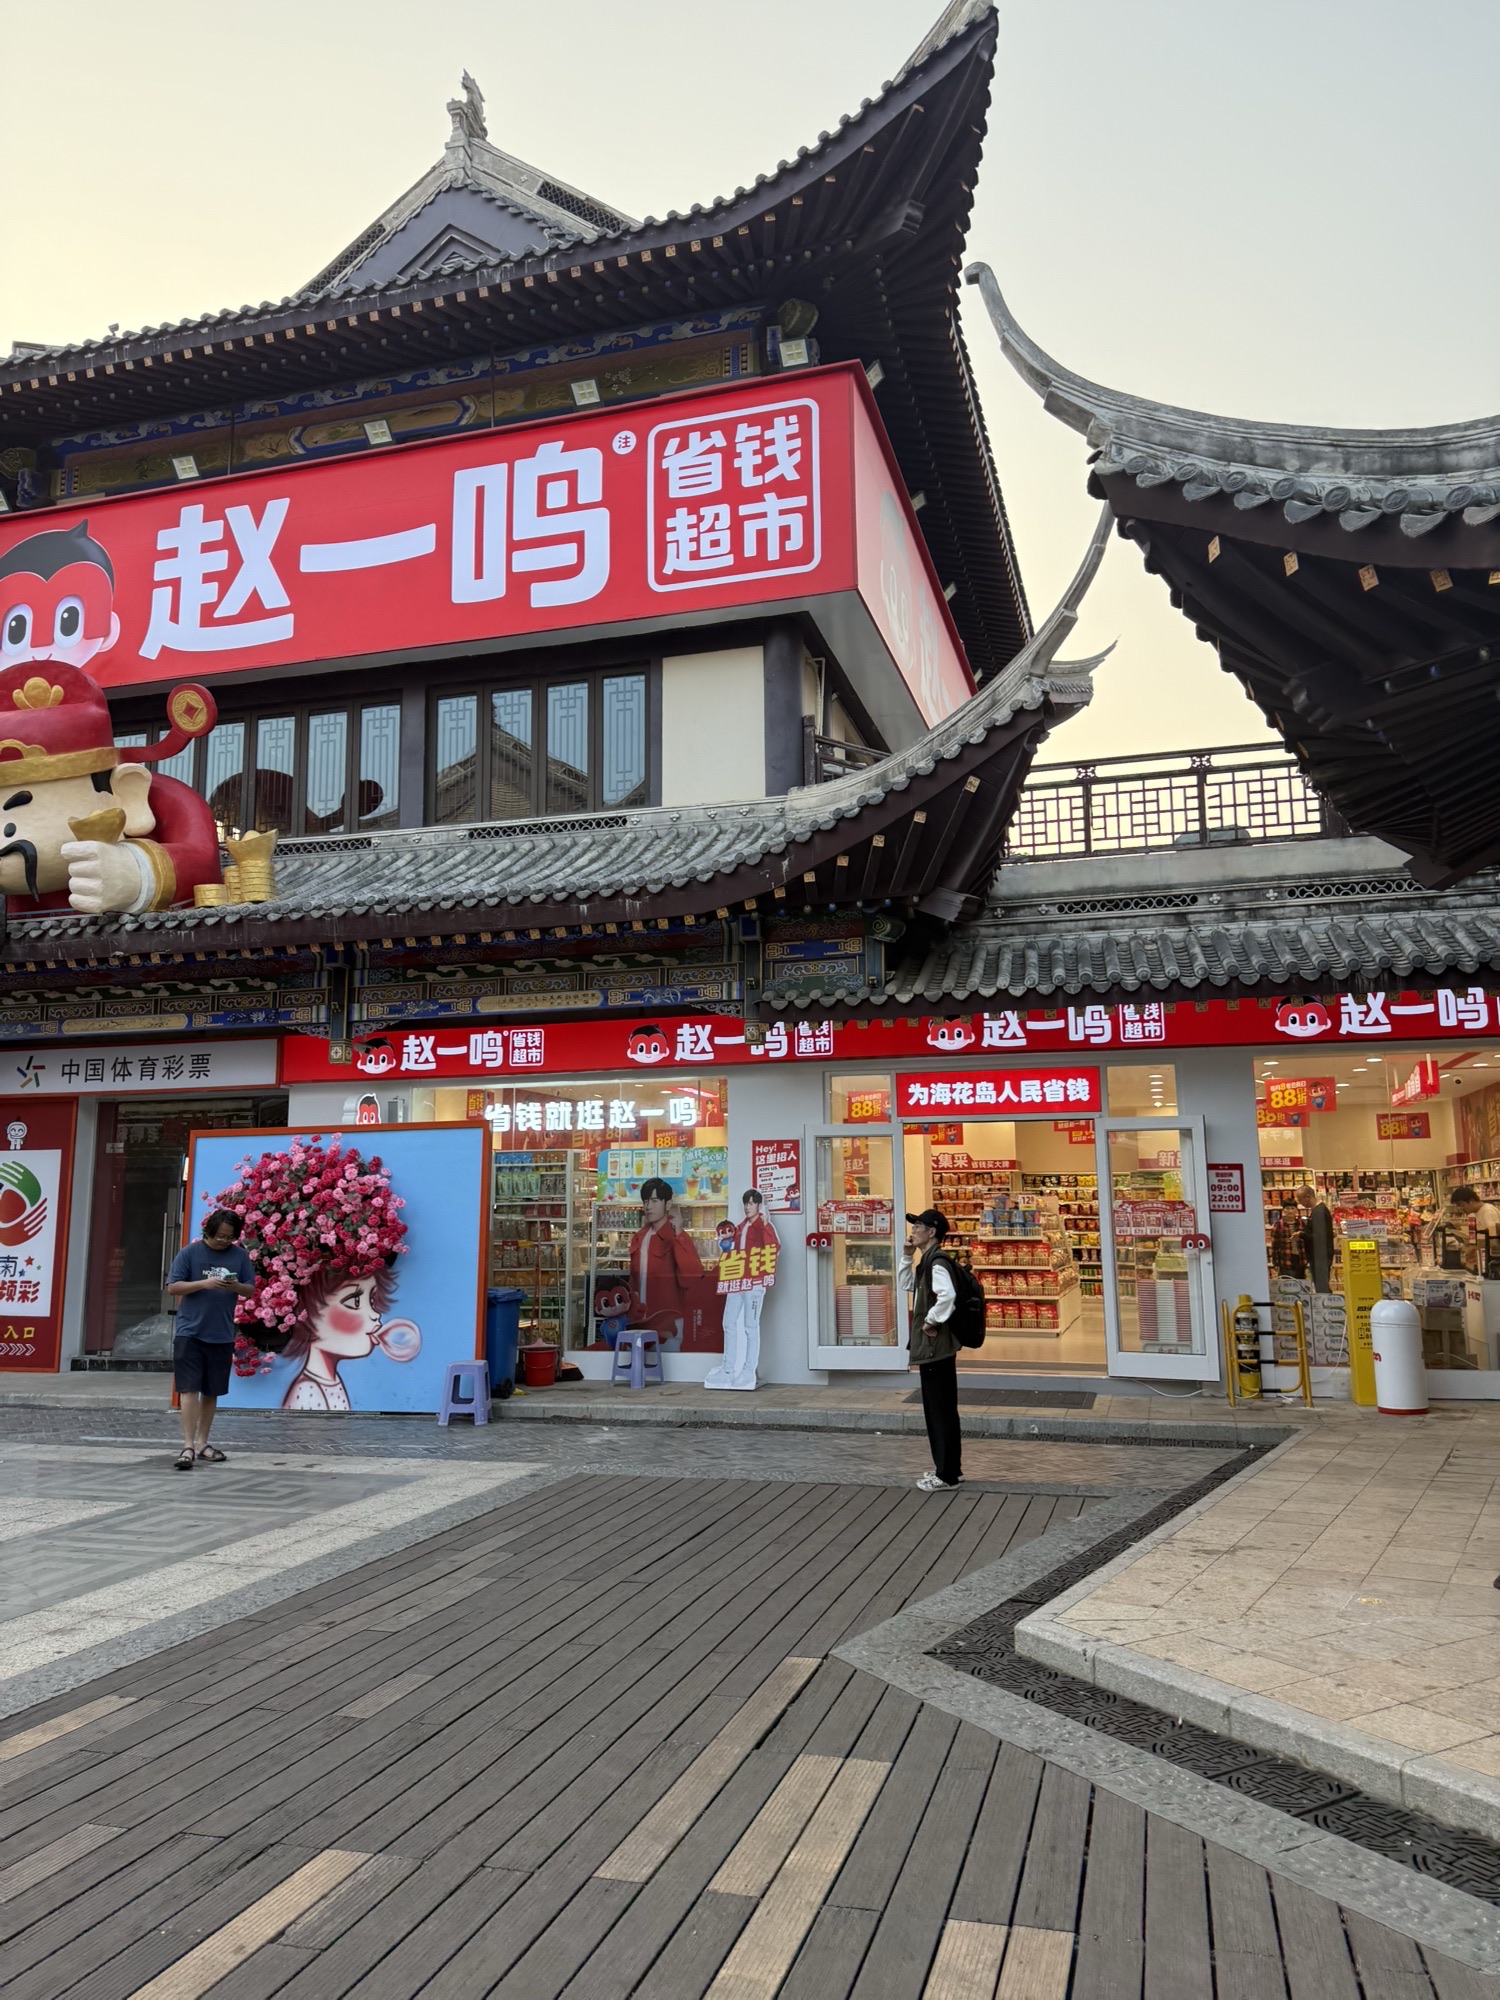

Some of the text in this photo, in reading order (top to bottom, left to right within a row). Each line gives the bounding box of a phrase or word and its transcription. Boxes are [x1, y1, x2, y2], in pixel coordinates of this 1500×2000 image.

[662, 415, 803, 499] 省钱
[663, 492, 808, 576] 超市
[138, 441, 611, 660] 赵一鸣
[1339, 987, 1488, 1034] 赵一鸣
[981, 1004, 1112, 1046] 赵一鸣
[1124, 1021, 1162, 1039] 超市
[512, 1032, 542, 1048] 省钱
[798, 1037, 831, 1053] 超市
[400, 1031, 504, 1071] 赵一鸣
[512, 1048, 542, 1063] 超市
[60, 1052, 212, 1084] 中国体育彩票
[907, 1078, 1091, 1106] 为海花岛人民省钱
[484, 1097, 698, 1132] 省钱就逛赵一鸣
[755, 1143, 777, 1154] Hey!
[755, 1150, 798, 1166] 这里招人
[971, 1160, 1010, 1169] 省钱买大牌
[1211, 1184, 1239, 1192] 09:00
[1211, 1194, 1241, 1202] 22:00
[719, 1243, 777, 1280] 省钱
[716, 1274, 775, 1293] 就逛赵一鸣
[4, 1325, 35, 1340] 入口
